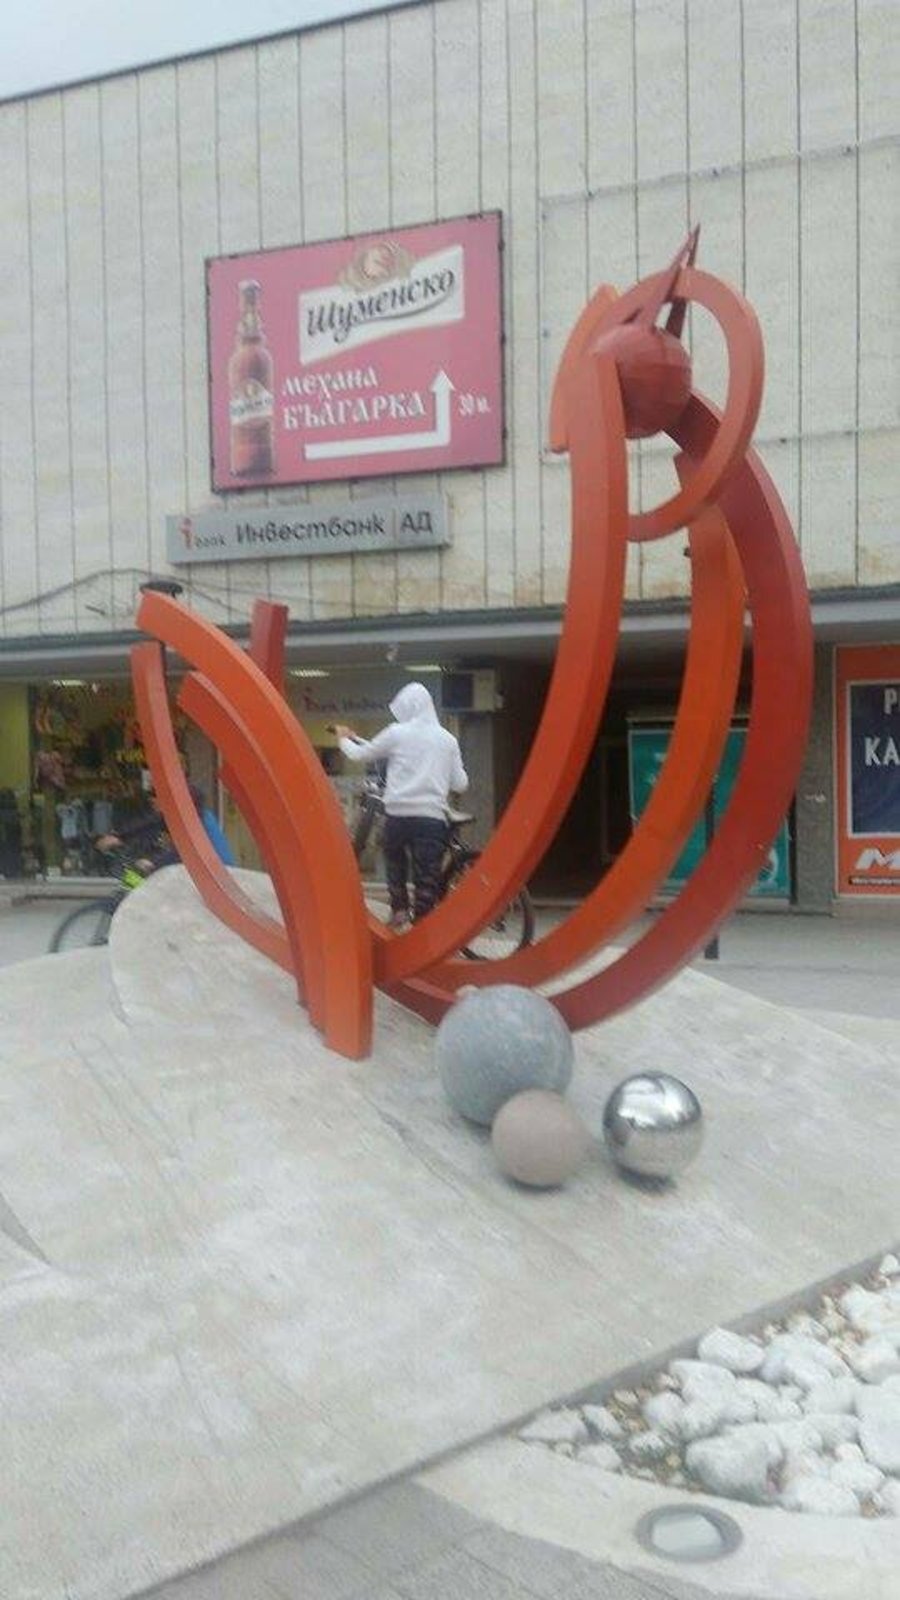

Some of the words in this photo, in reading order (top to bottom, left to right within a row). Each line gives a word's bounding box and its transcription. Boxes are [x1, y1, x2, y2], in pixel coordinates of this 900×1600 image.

[306, 269, 455, 343] Шуменско
[283, 366, 378, 399] механа
[235, 514, 385, 545] Инвестбанк
[401, 511, 433, 534] АД
